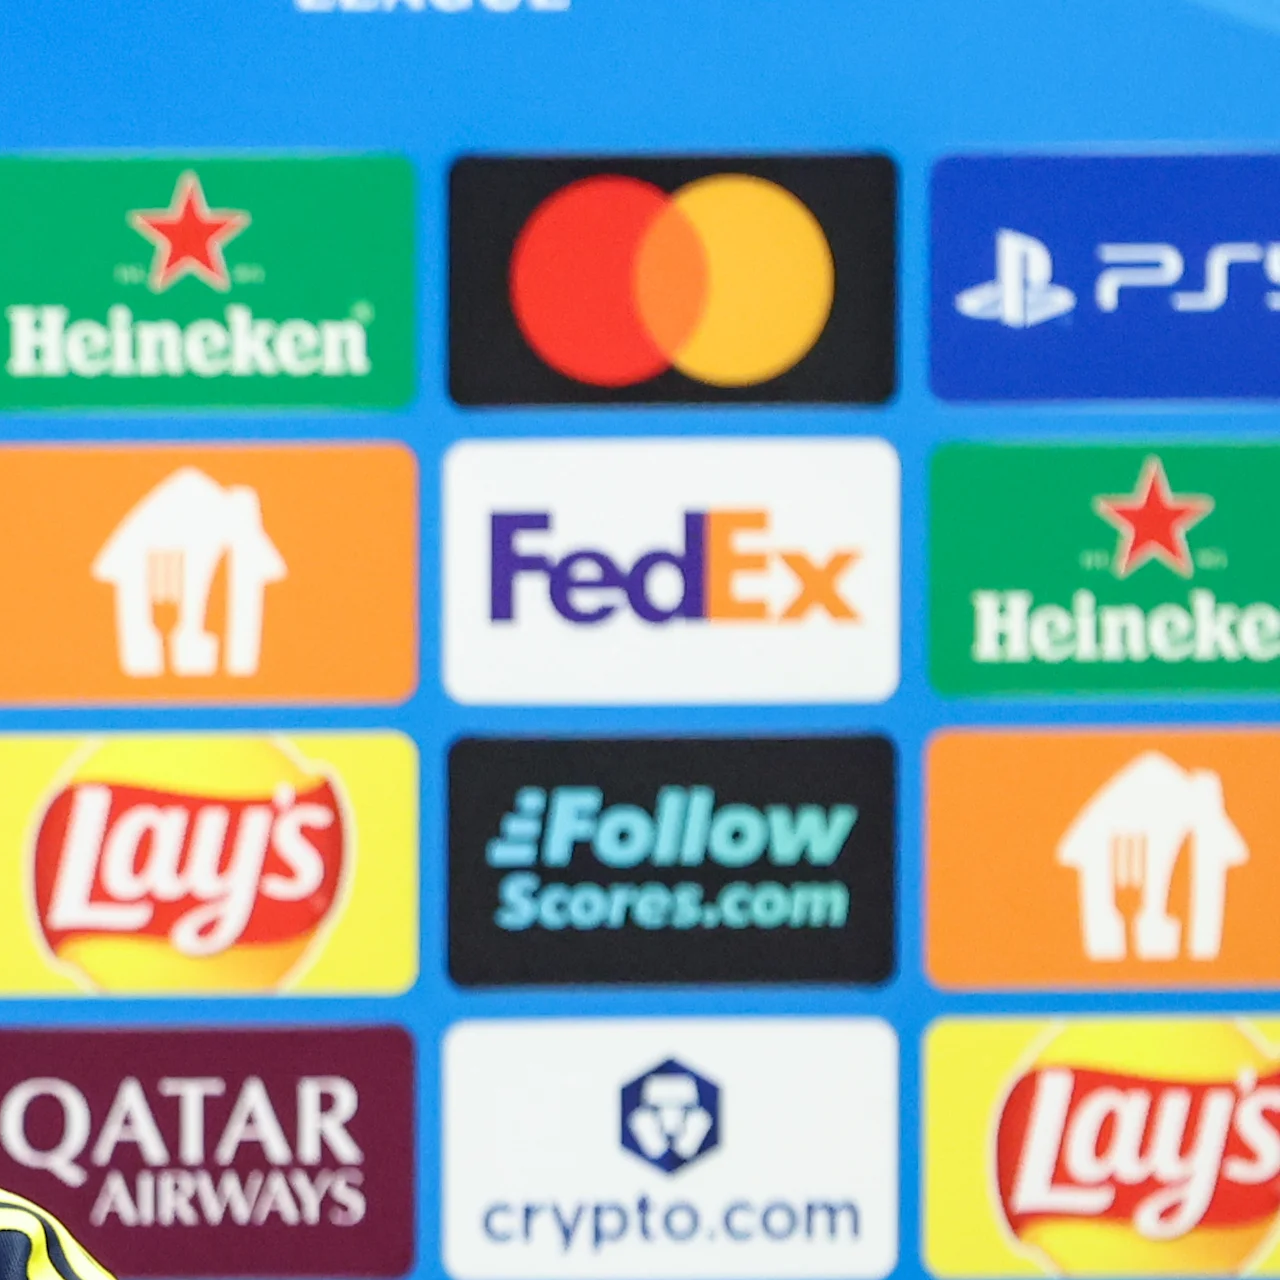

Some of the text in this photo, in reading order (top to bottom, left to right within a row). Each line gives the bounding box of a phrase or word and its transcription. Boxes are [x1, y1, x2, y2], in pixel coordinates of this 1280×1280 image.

[1095, 242, 1280, 312] PS
[7, 304, 372, 378] Heineken
[488, 508, 862, 629] FedEx
[972, 588, 1280, 663] Heineke
[540, 785, 859, 868] Follow
[47, 783, 334, 956] Lay's
[494, 871, 850, 931] Scores.com
[89, 1168, 366, 1227] AIRWAYS
[481, 1192, 861, 1253] crypto.com
